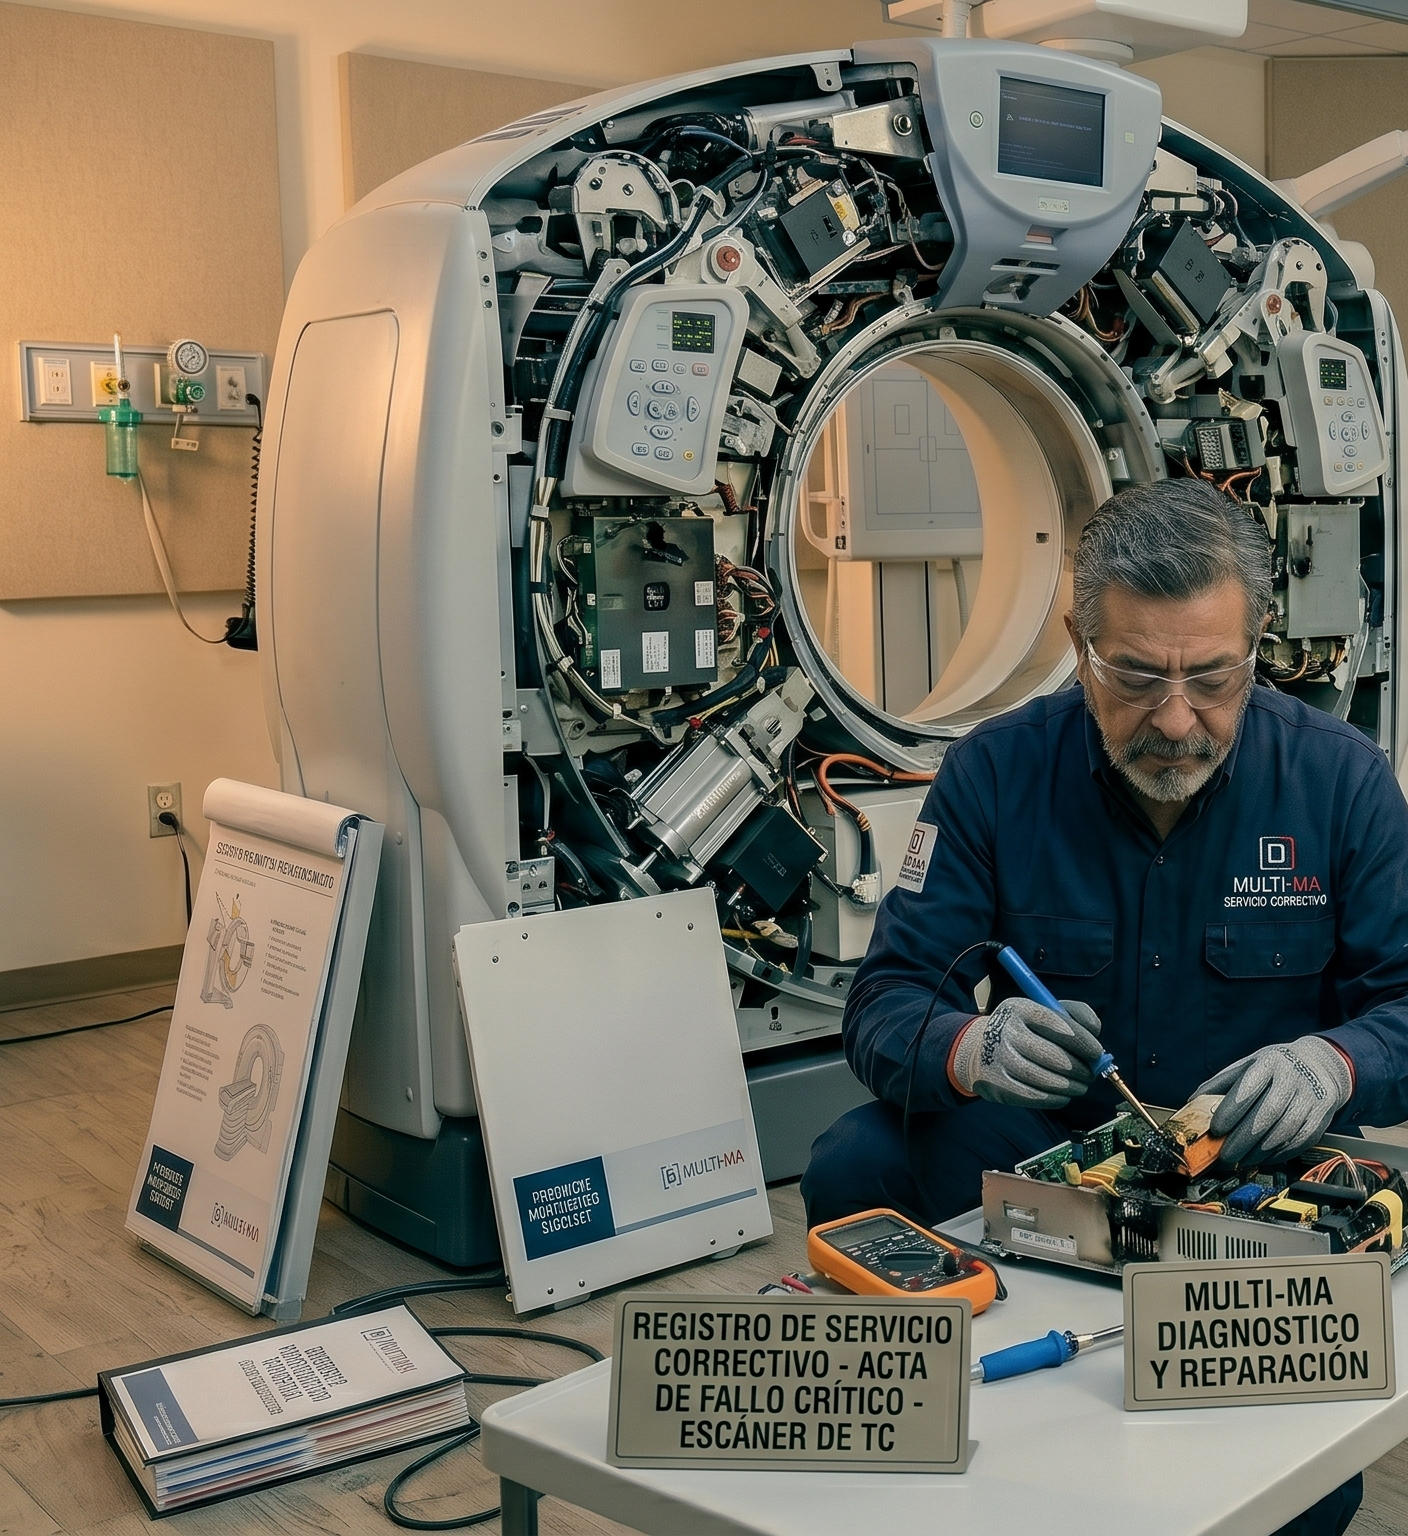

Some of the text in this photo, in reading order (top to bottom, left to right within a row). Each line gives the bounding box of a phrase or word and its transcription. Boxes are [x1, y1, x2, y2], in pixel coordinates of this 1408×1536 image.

[1223, 896, 1268, 908] SERVICIO
[1233, 876, 1322, 893] MULTI-MA
[683, 1149, 745, 1180] MULTI-MA
[1184, 1276, 1334, 1312] MULTI-MA
[633, 1311, 953, 1345] REGISTRO DE SERVICIO
[1157, 1313, 1360, 1351] DIAGNOSTICO
[654, 1347, 830, 1379] CORRECTIVO
[857, 1351, 928, 1381] ACTA
[1150, 1343, 1370, 1390] Y REPARACIÓN
[655, 1383, 691, 1412] DE
[699, 1384, 785, 1414] FALLO
[793, 1379, 905, 1416] CRÍTICO
[679, 1414, 896, 1453] ESCÁNER DE TC
